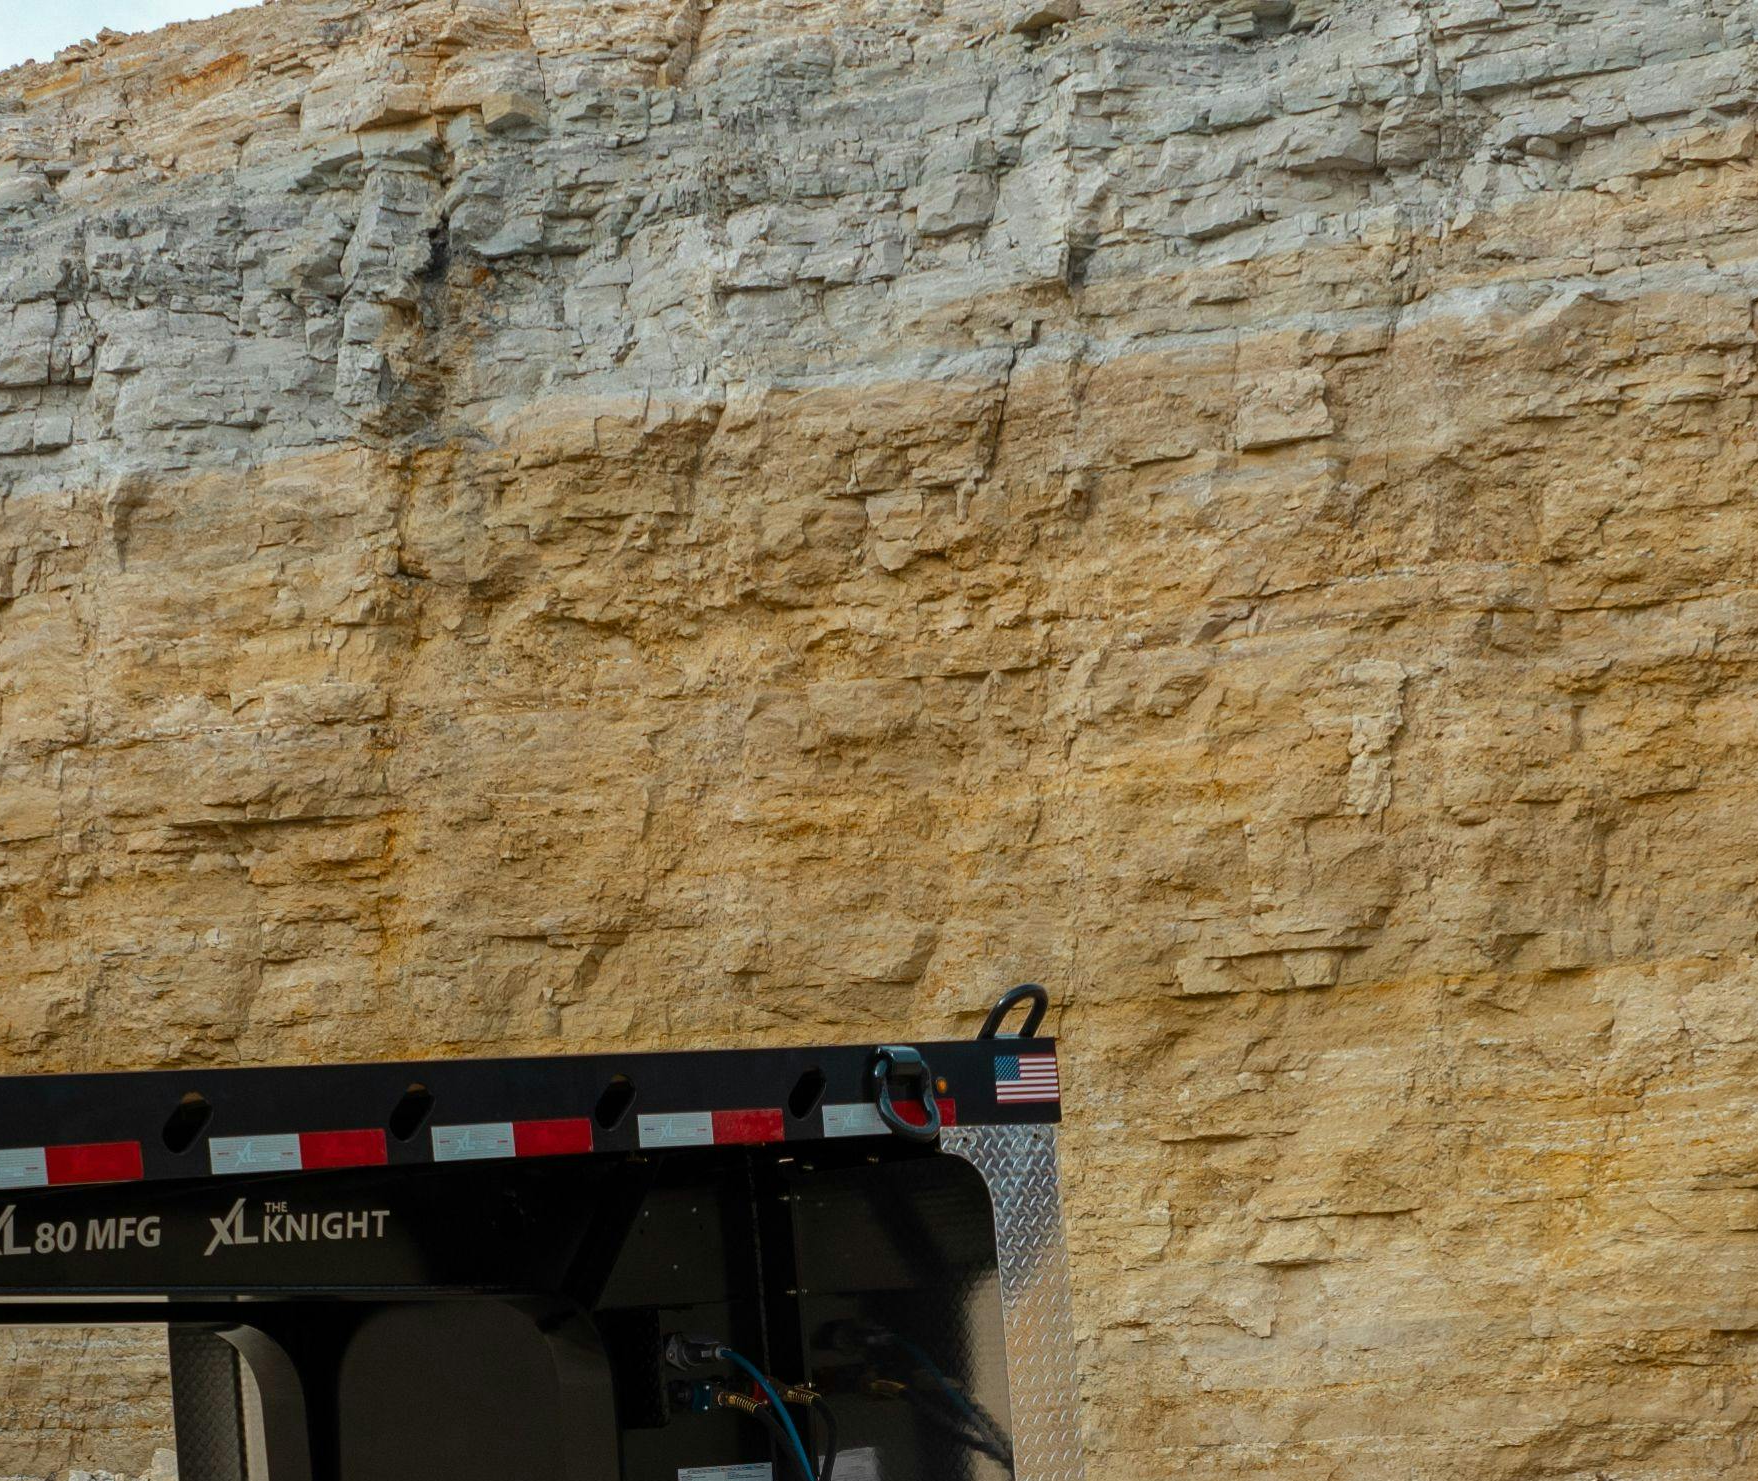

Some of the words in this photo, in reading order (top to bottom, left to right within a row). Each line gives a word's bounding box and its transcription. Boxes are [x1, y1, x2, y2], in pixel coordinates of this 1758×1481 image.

[265, 1201, 287, 1213] THE
[34, 1220, 77, 1254] 80
[85, 1216, 161, 1250] MFG
[203, 1198, 259, 1256] XL
[263, 1210, 390, 1243] KNIGHT
